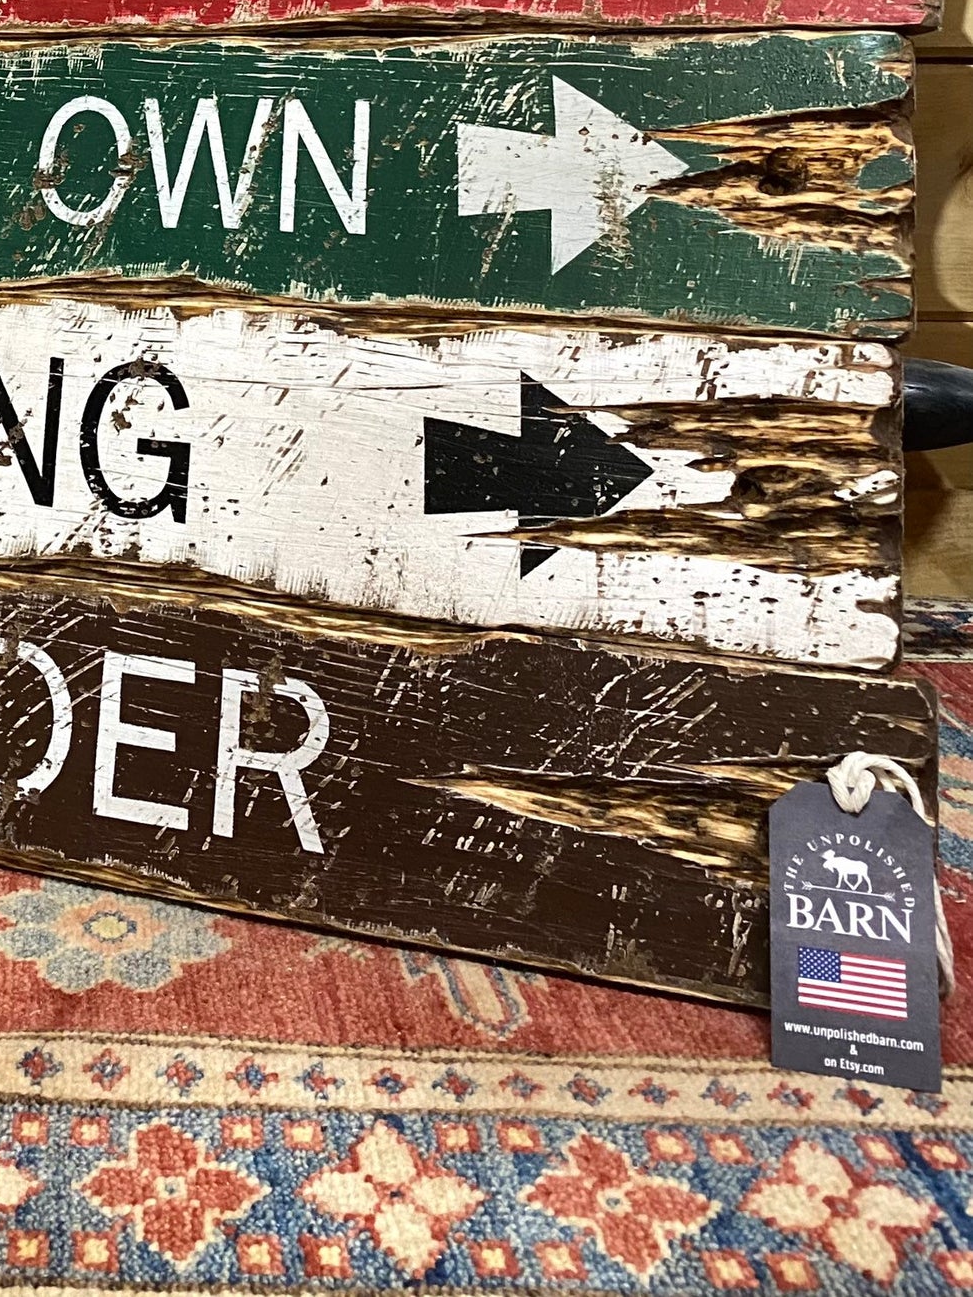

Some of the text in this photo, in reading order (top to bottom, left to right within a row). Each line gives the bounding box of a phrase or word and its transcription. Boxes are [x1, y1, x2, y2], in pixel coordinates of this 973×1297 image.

[36, 93, 371, 236] OWN
[783, 833, 916, 909] THE UNPOLISHED
[785, 892, 914, 944] BARN
[784, 1021, 925, 1052] www.unpolishedbarn.com
[849, 1044, 859, 1056] &
[824, 1057, 885, 1076] on Etsy.com
